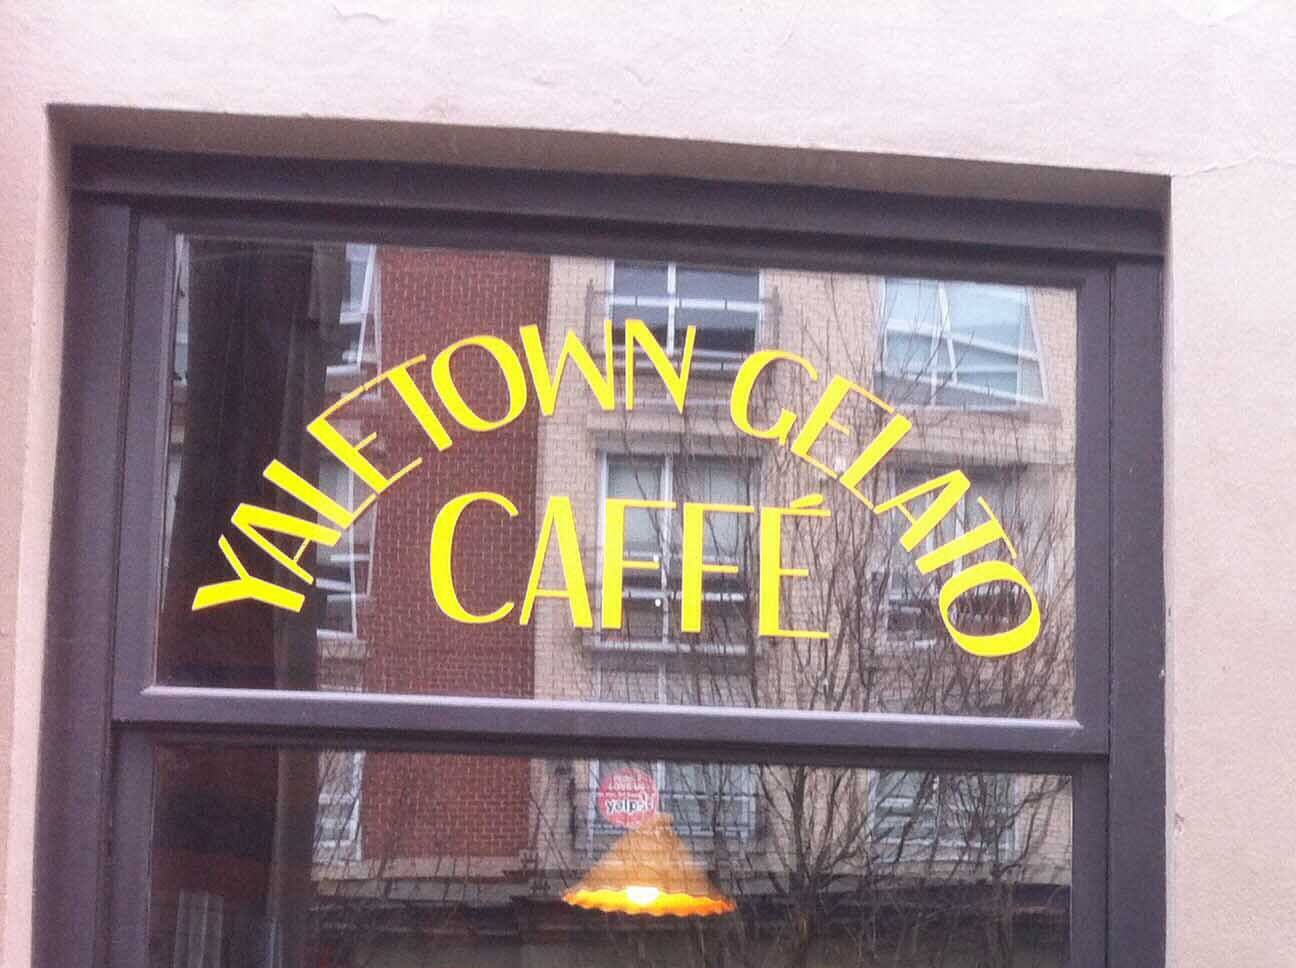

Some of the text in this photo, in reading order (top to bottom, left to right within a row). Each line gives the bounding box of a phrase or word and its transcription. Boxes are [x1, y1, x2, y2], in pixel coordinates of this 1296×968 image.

[193, 318, 1041, 657] YALETOWN GELATO
[430, 490, 831, 639] CAFFÉ
